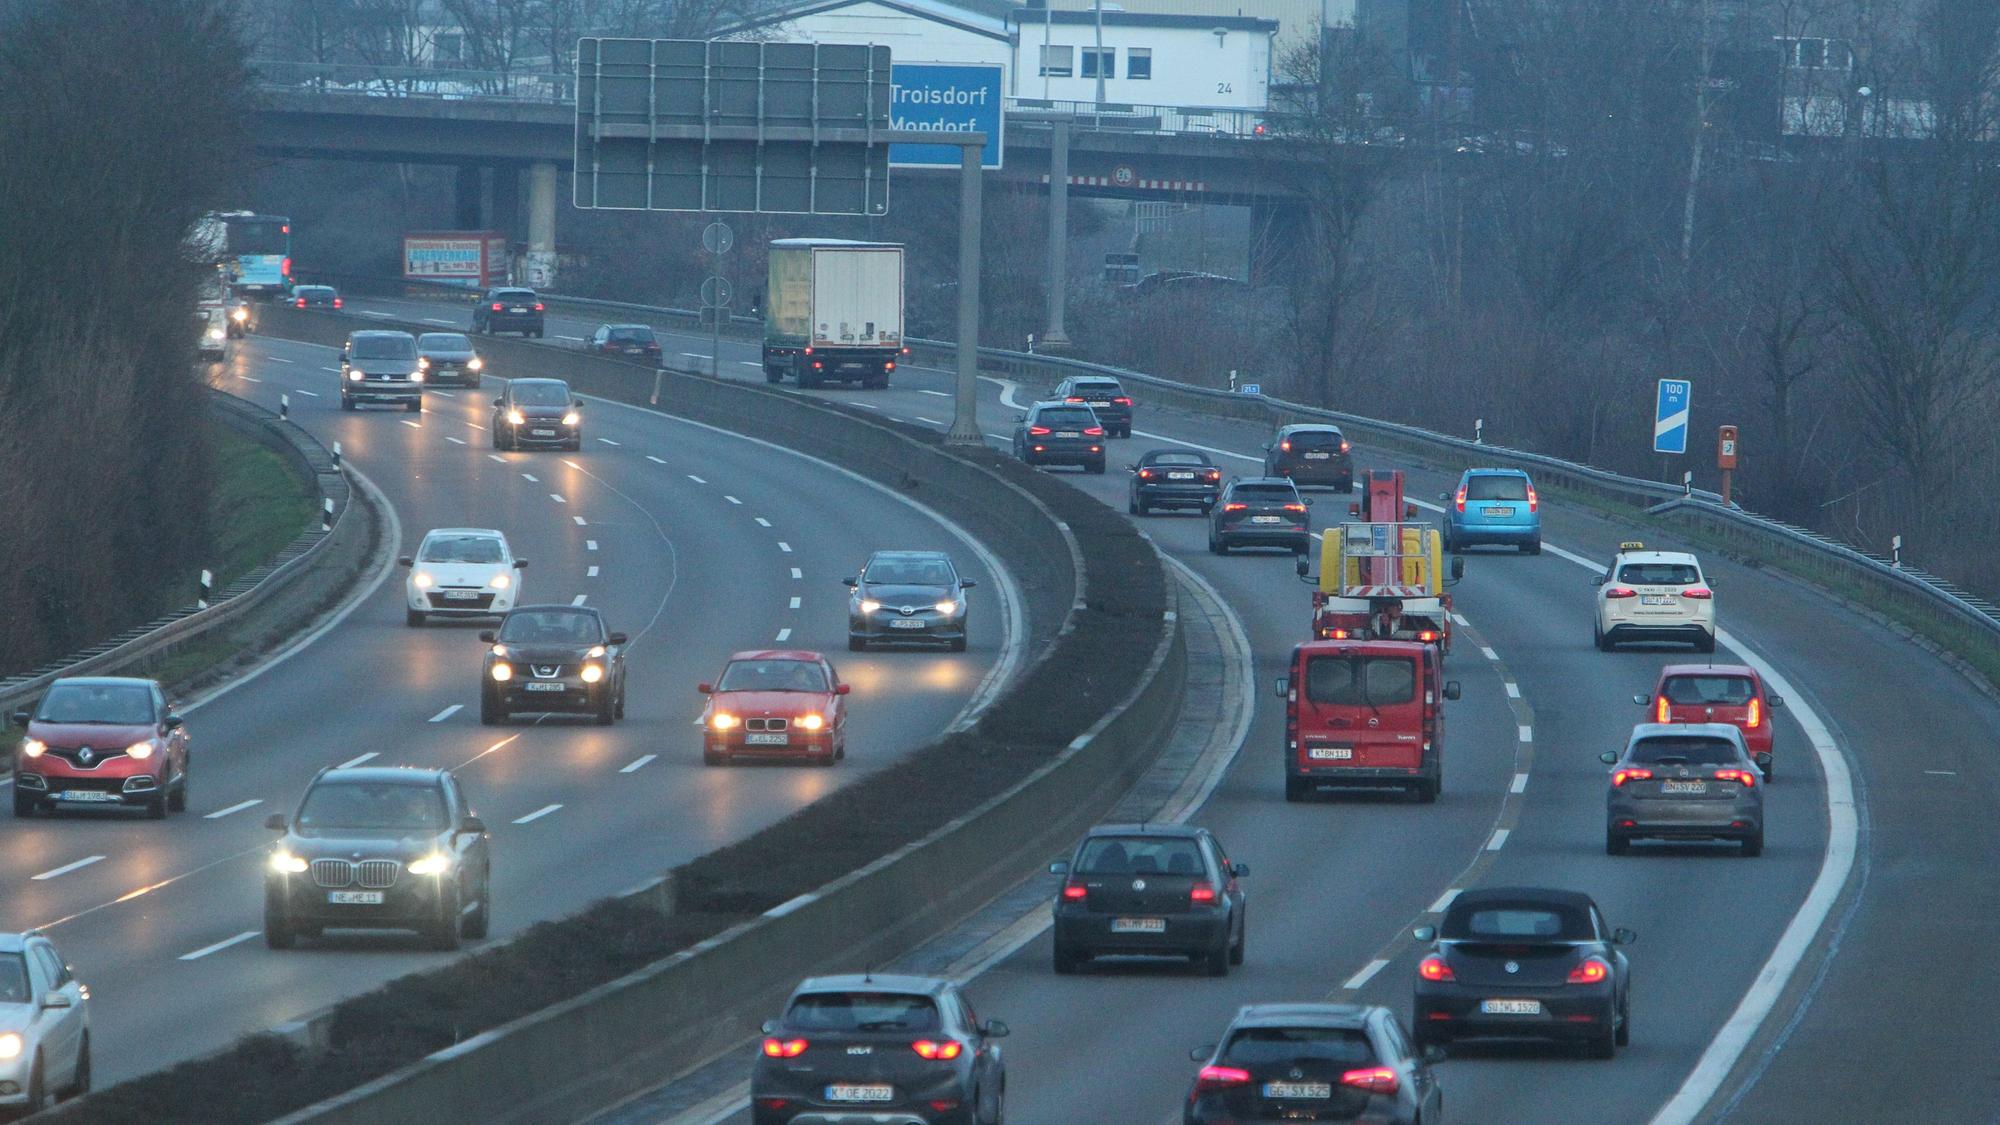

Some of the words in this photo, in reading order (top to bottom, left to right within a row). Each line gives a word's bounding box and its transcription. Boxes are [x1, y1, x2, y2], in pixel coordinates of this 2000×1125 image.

[1217, 82, 1232, 94] 24
[890, 84, 987, 105] Troisdorf
[889, 116, 976, 132] Mondorf
[1665, 384, 1683, 395] 100
[1335, 750, 1349, 758] 113
[1665, 783, 1676, 791] BN
[367, 893, 376, 902] 11
[1488, 1003, 1498, 1012] SU
[1518, 1003, 1539, 1012] 1520
[832, 1088, 838, 1098] K
[864, 1088, 889, 1099] 2022
[1269, 1085, 1284, 1097] GG
[1292, 1085, 1305, 1097] SX
[1308, 1085, 1329, 1097] 525
